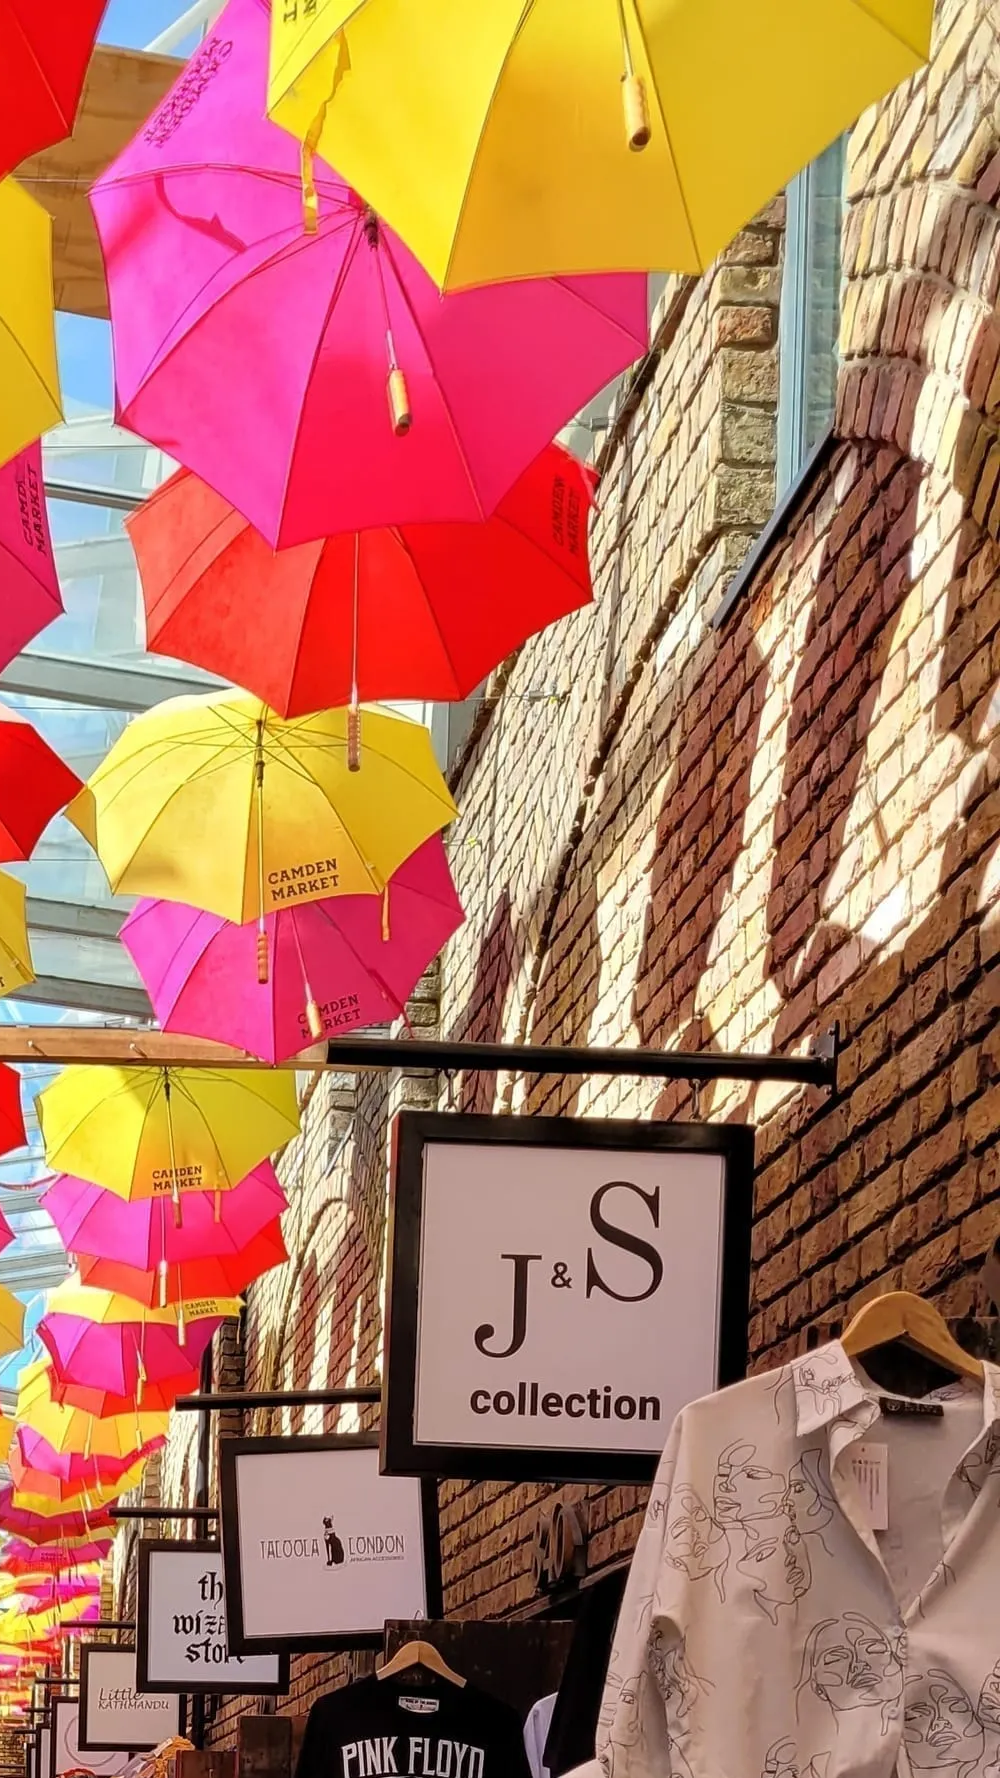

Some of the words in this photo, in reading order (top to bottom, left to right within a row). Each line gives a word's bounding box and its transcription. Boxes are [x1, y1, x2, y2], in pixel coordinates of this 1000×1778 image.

[16, 480, 34, 546] CAMD
[28, 463, 48, 556] MARKET
[268, 858, 338, 885] CAMDEN
[271, 874, 340, 901] MARKET
[297, 994, 360, 1025] CMDEN
[301, 1008, 362, 1040] MRKET
[152, 1165, 203, 1180] CAMDEN
[470, 1383, 661, 1421] collection
[260, 1539, 320, 1559] TALOOLA
[348, 1535, 404, 1555] LONDON
[198, 1571, 224, 1610] th
[98, 1700, 170, 1710] KATHMANDU
[99, 1687, 144, 1701] Little
